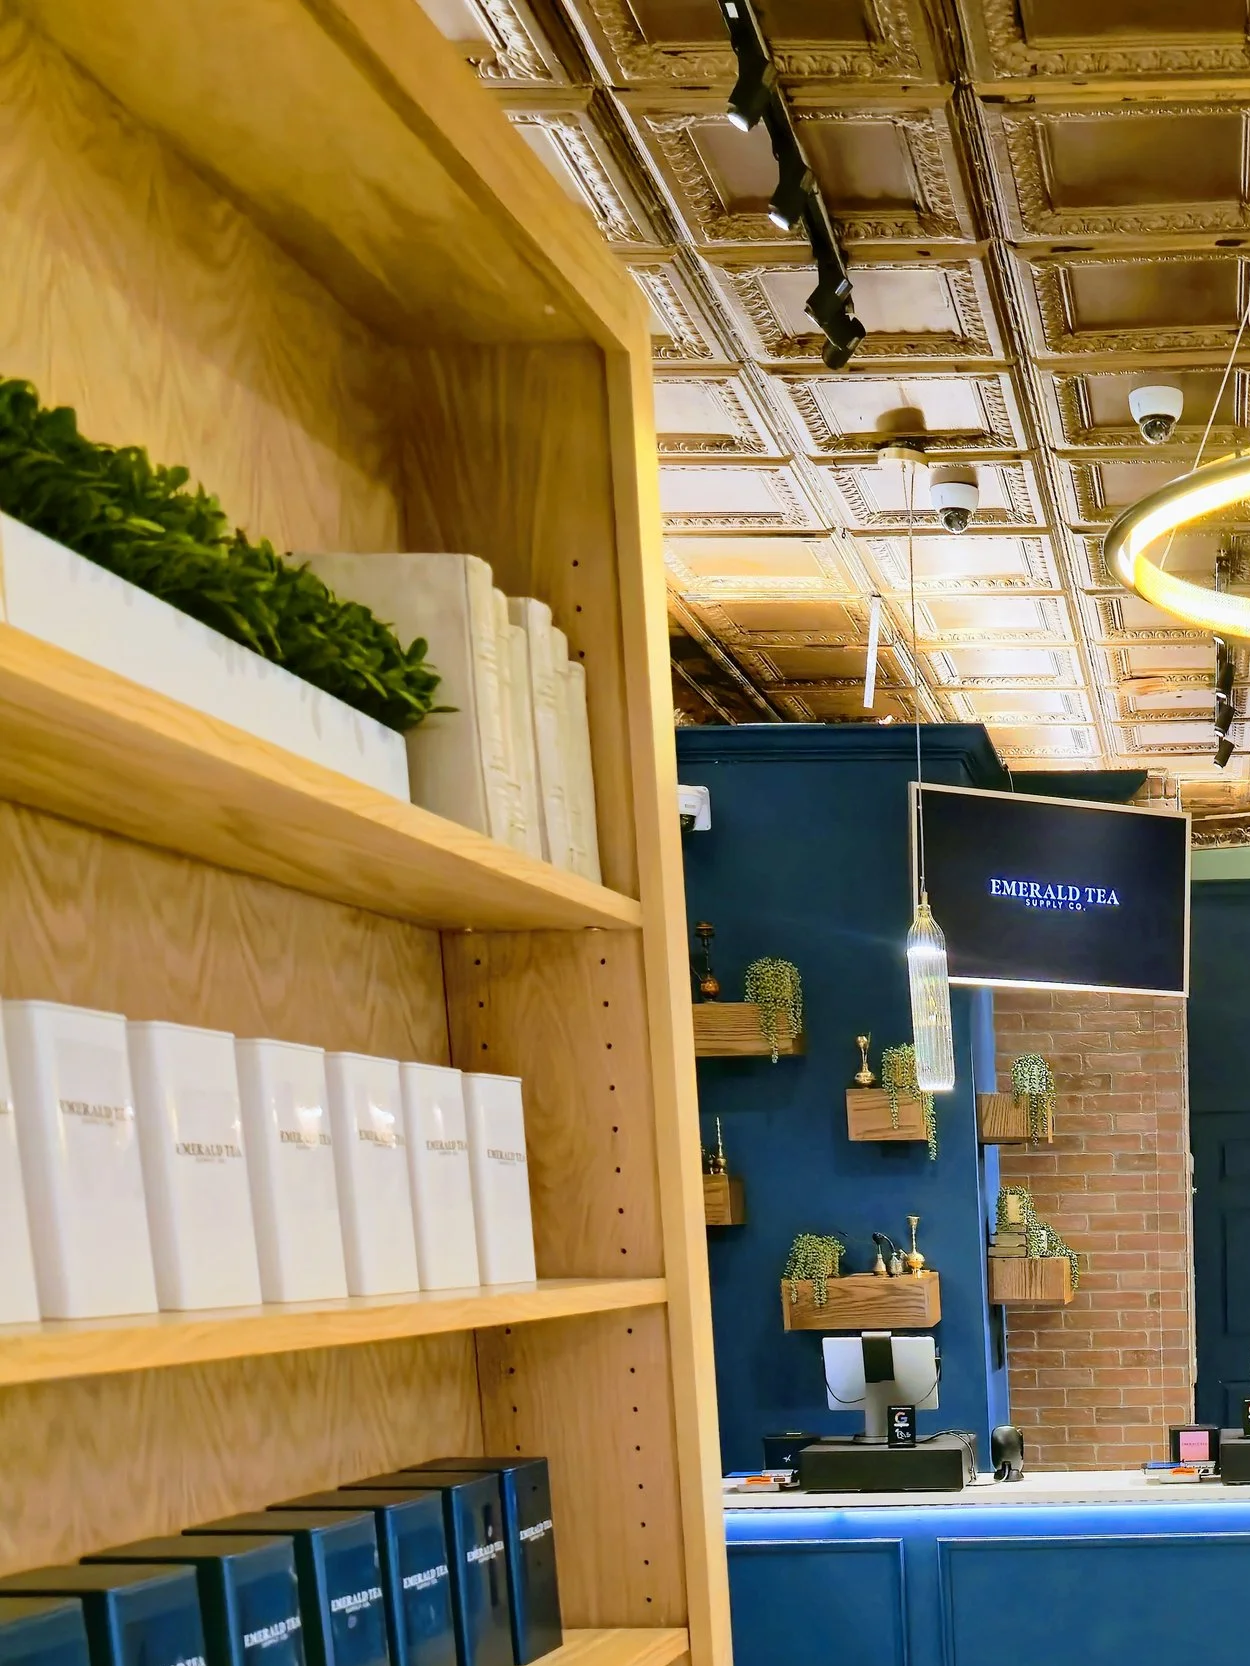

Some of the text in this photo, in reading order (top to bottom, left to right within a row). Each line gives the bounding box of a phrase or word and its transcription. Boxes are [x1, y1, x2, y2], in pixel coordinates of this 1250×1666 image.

[990, 879, 1120, 905] EMERALD TEA
[1025, 898, 1086, 912] SUPPLY CO.
[403, 1568, 436, 1589] EMERALD
[435, 1564, 449, 1577] TEA
[330, 1590, 368, 1612] EMERALD
[367, 1586, 383, 1600] TEA
[243, 1621, 287, 1649] EMERALD
